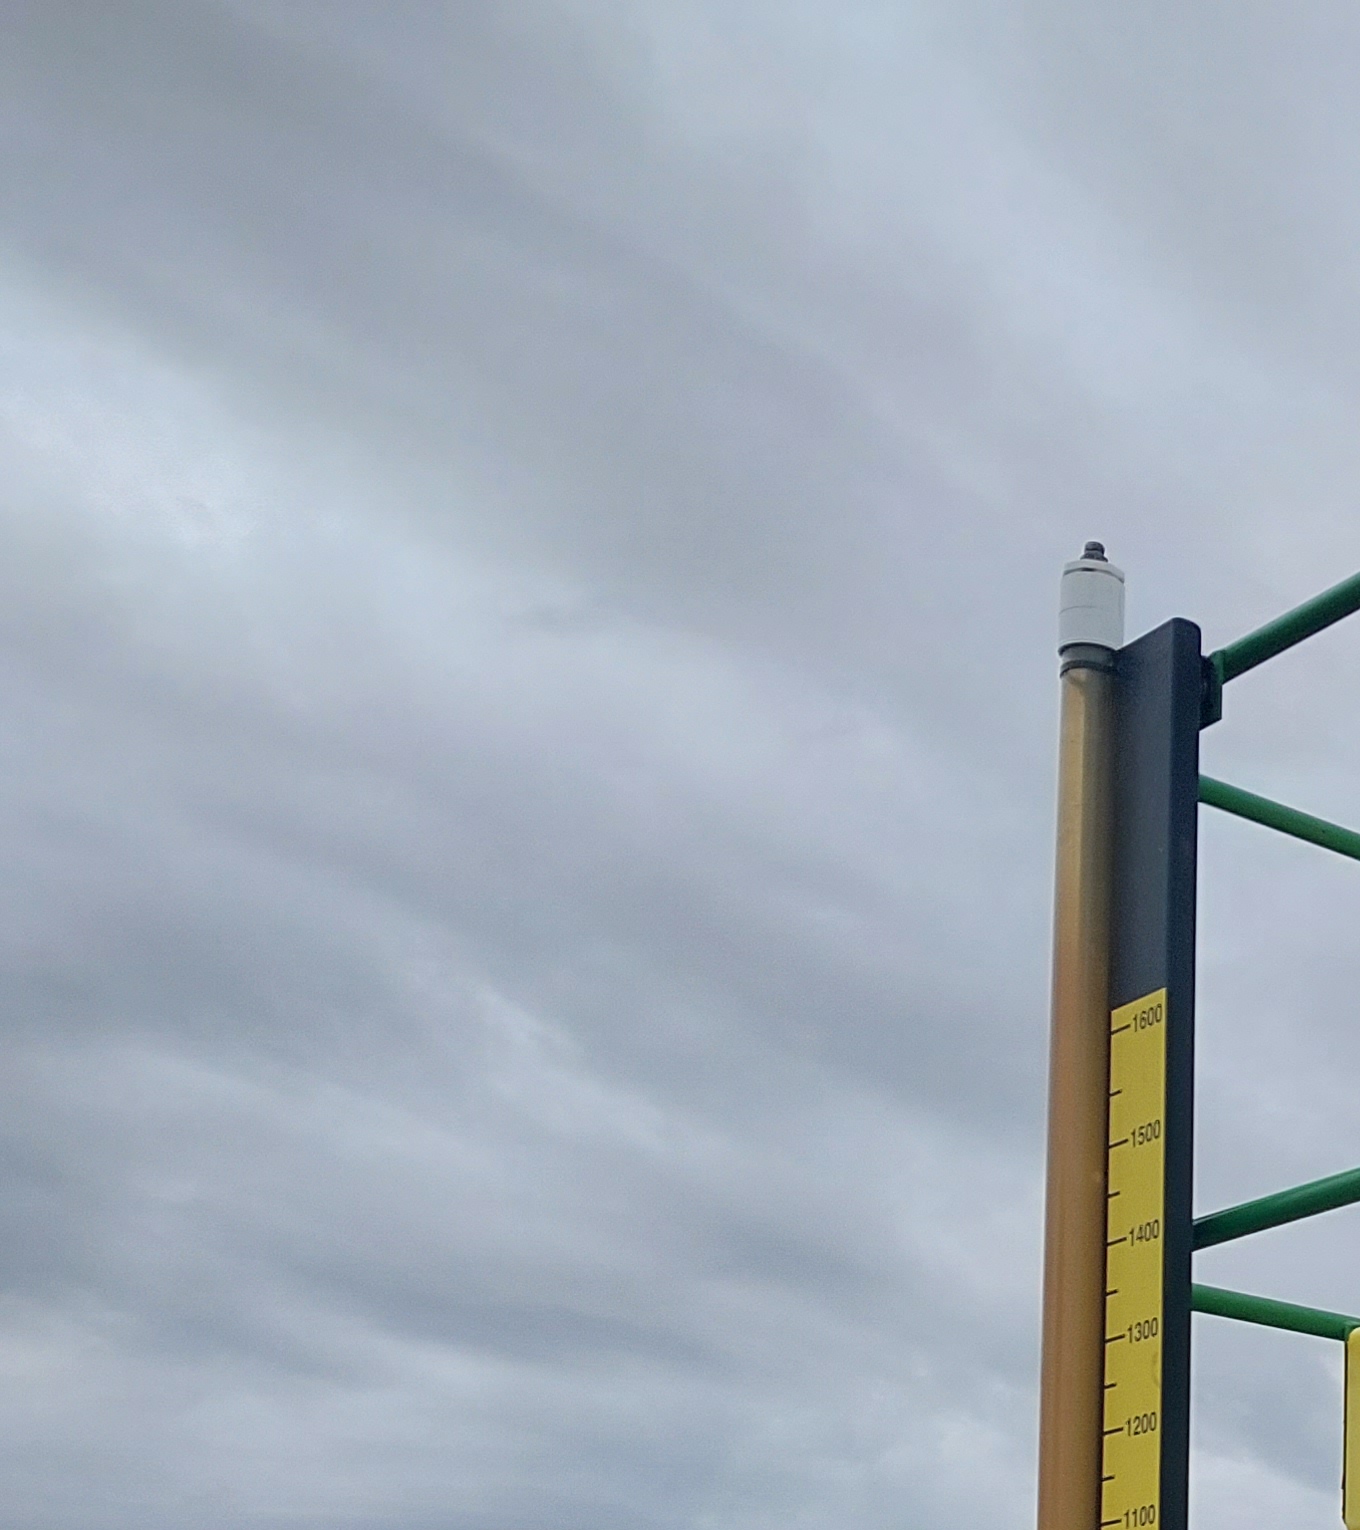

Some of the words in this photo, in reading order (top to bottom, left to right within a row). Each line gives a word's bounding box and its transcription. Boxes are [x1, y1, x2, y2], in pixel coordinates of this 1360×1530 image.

[1131, 1004, 1163, 1033] 1600
[1129, 1120, 1161, 1149] 1500
[1128, 1219, 1160, 1247] 1400
[1126, 1317, 1159, 1344] 1300
[1124, 1412, 1157, 1437] 1200
[1122, 1504, 1156, 1529] 1100
